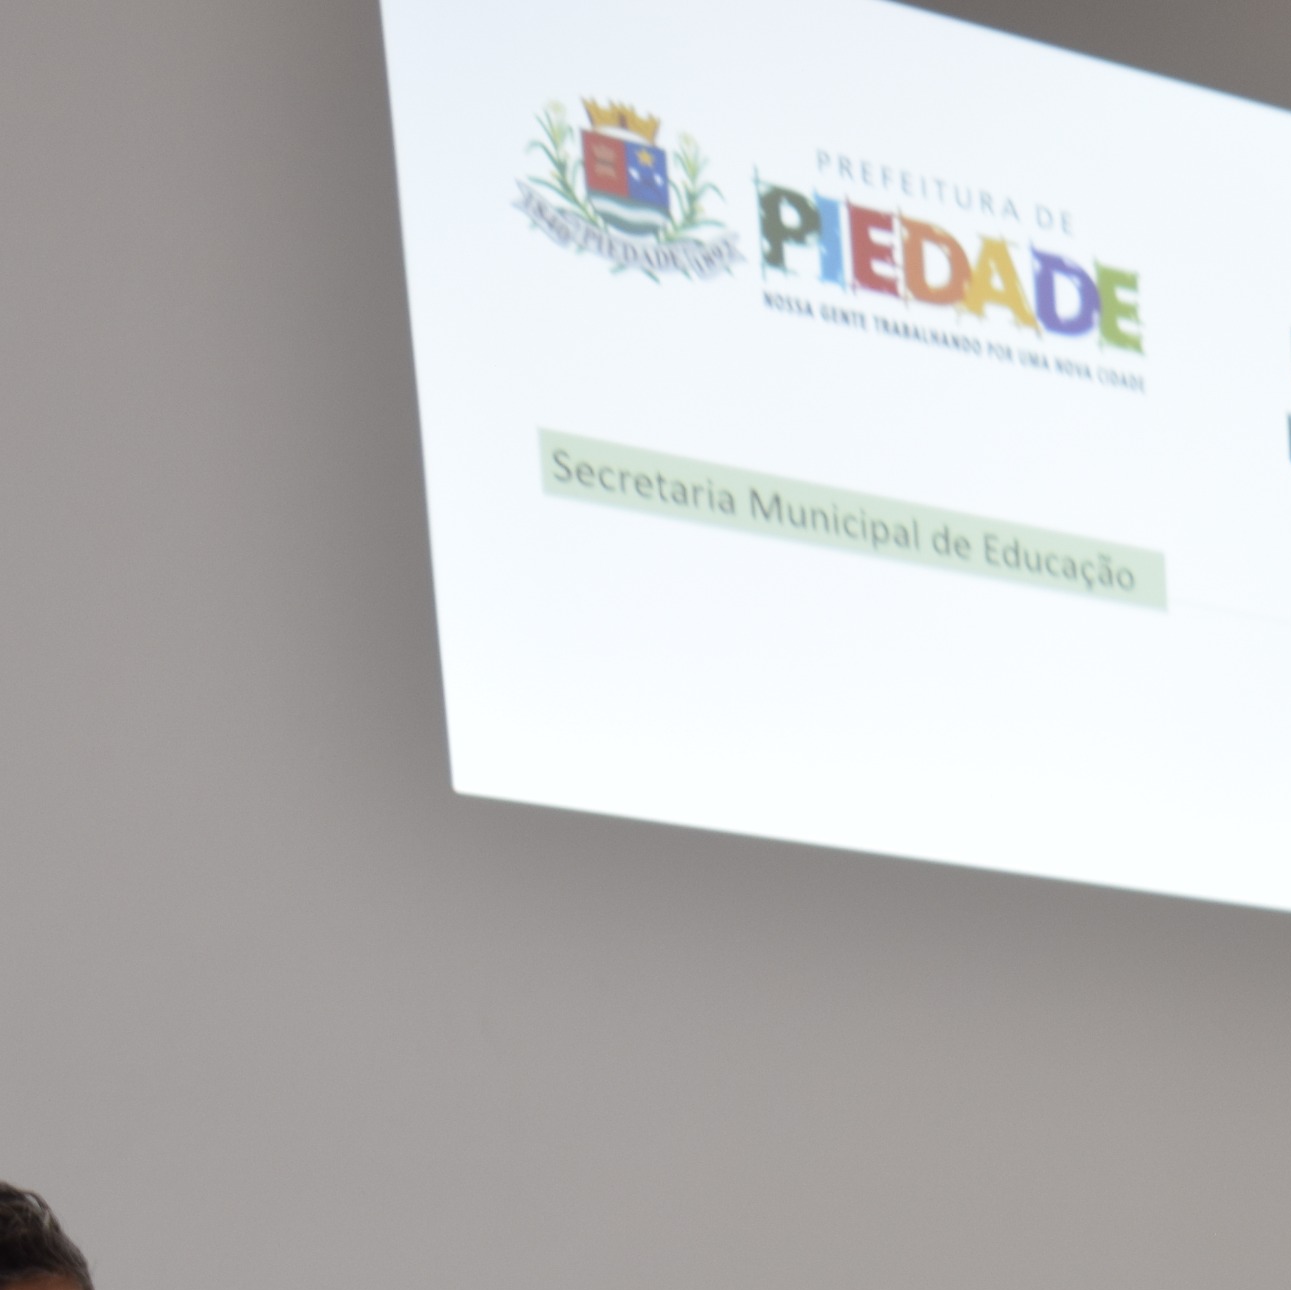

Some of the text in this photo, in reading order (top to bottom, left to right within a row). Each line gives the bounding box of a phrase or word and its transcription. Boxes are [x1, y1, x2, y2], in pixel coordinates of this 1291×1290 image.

[816, 147, 1076, 238] PREFEITURA DE
[753, 170, 1146, 356] PIEDADE
[762, 290, 1146, 395] NOSSA GENTE TRABALHANDO POR UMA NOVA CIDADE
[551, 448, 1136, 592] Secretaria Municipal de Educação
